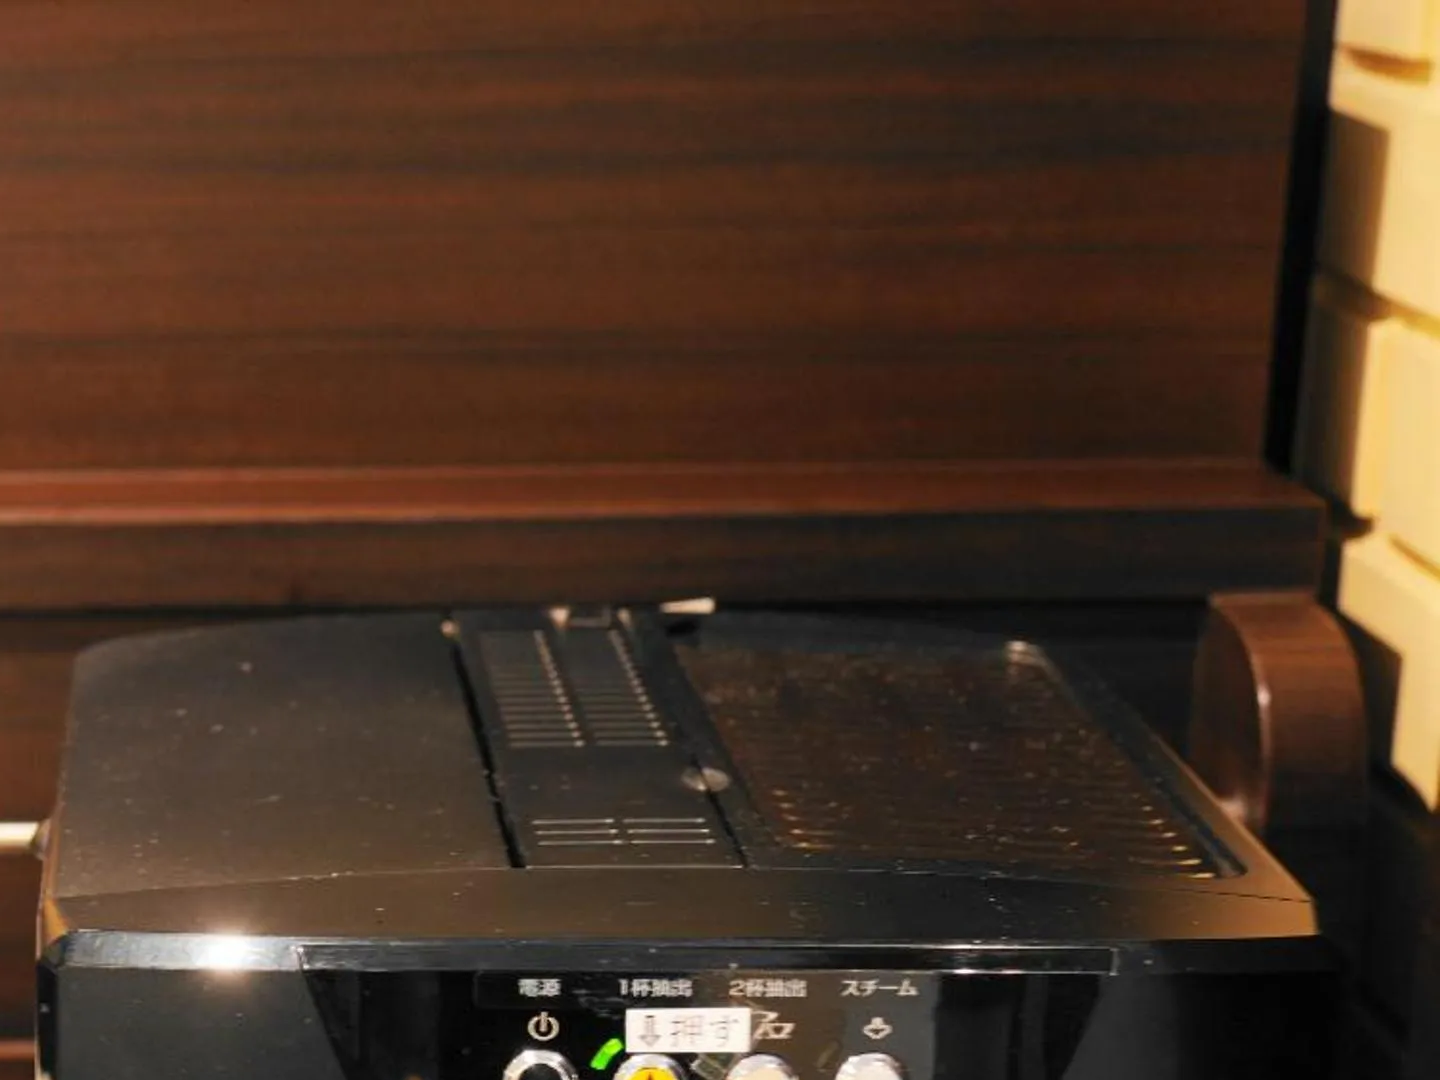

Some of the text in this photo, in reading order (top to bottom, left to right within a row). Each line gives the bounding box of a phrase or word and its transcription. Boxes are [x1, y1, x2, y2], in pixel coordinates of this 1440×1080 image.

[841, 979, 919, 998] スチーム
[669, 1014, 741, 1049] 押す
